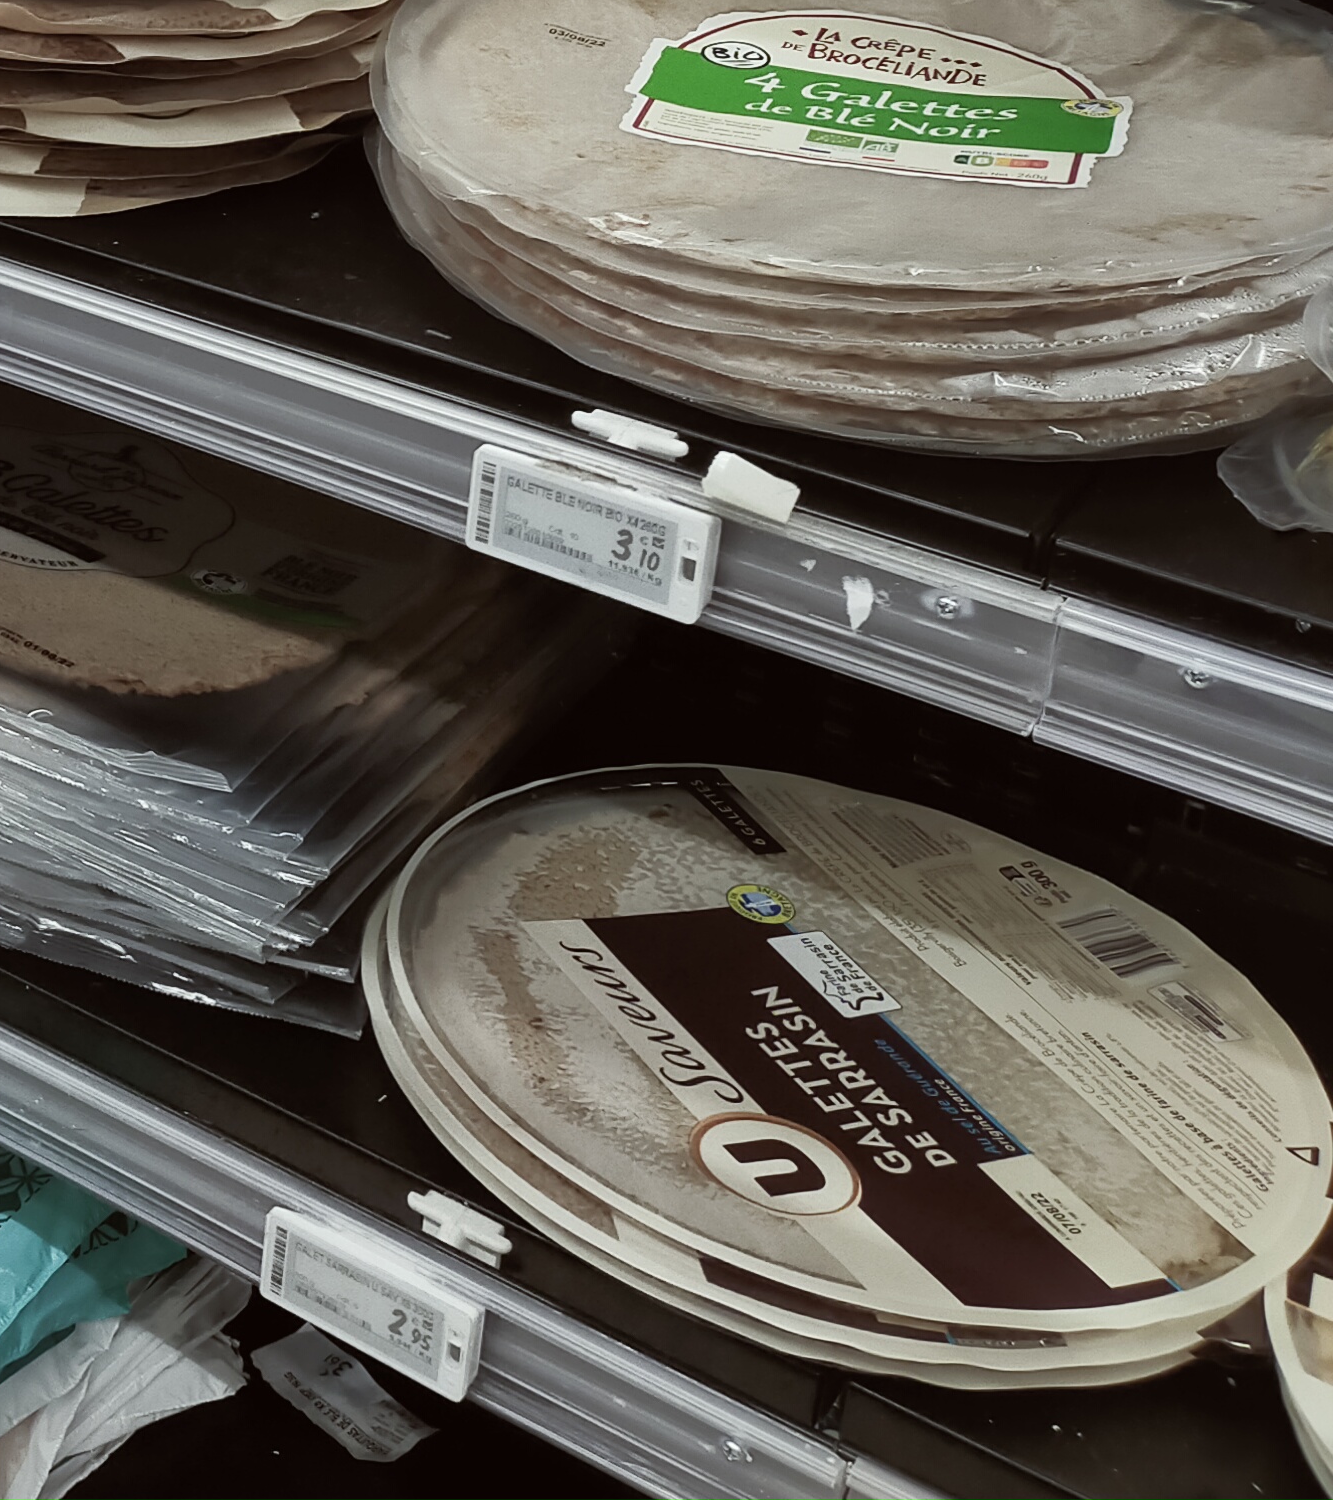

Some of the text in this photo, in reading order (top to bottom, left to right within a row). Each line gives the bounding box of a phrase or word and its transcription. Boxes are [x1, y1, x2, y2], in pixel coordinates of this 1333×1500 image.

[781, 40, 989, 88] DE BROCÉLIANDE
[815, 26, 938, 62] LA CRÊPE
[744, 72, 1020, 122] 4 Galettes
[745, 98, 1003, 142] de Blé Noir
[507, 476, 553, 500] GALETTE
[559, 940, 745, 1104] Saveurs
[746, 1021, 913, 1175] GALETTES
[751, 984, 958, 1168] DE SARRASIN
